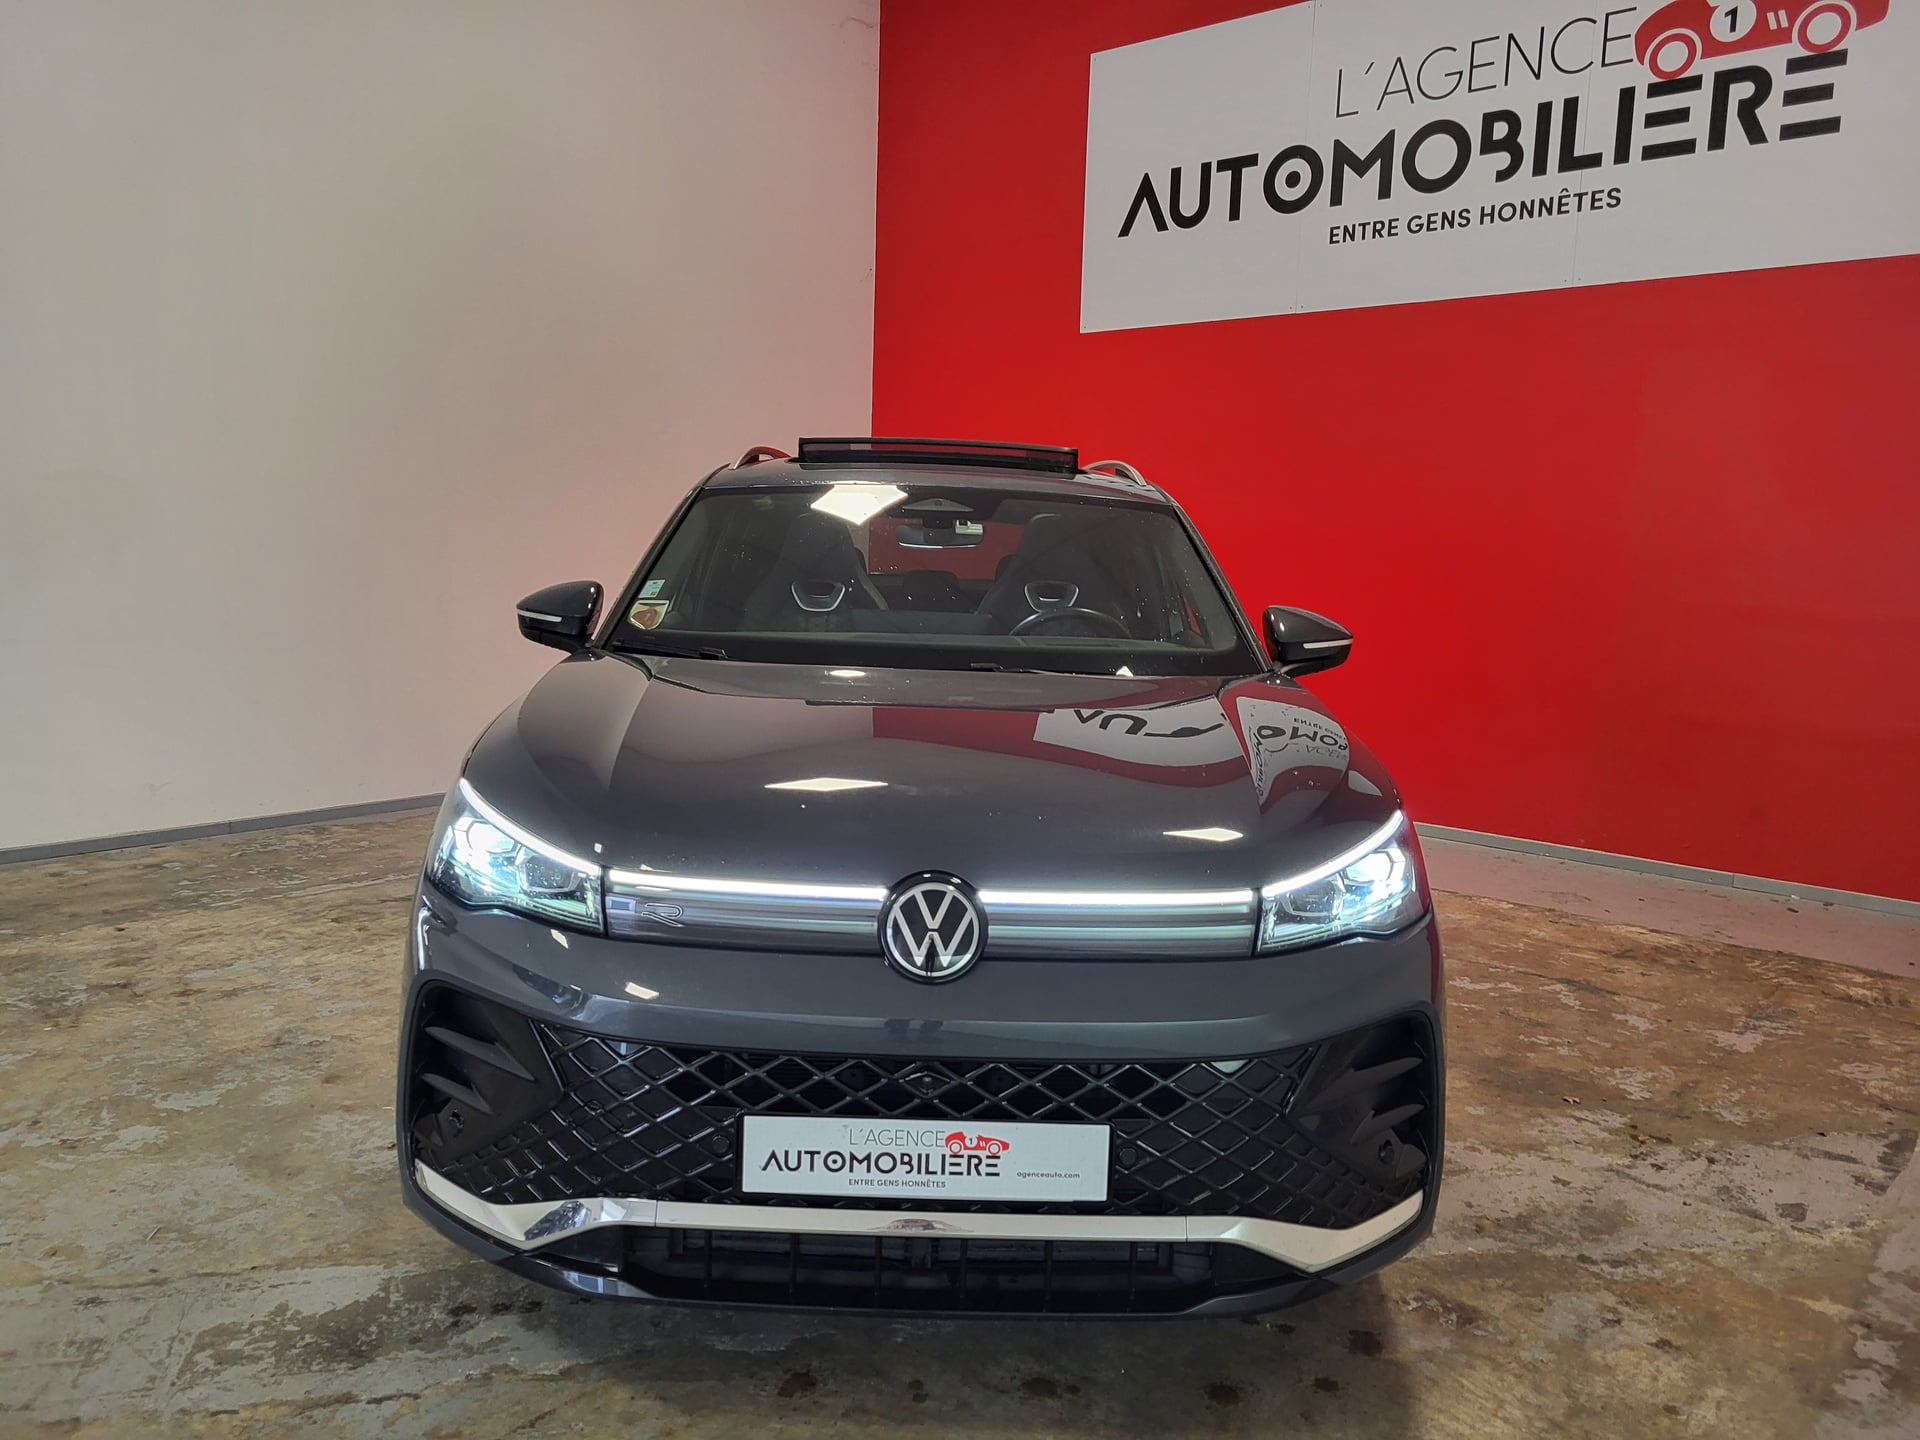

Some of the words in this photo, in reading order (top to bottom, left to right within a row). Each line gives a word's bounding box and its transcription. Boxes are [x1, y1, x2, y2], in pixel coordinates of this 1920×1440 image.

[1723, 6, 1739, 34] 1
[1335, 6, 1637, 118] L'AGENCE
[1329, 217, 1400, 245] ENTRE
[1406, 207, 1472, 235] GENS
[1479, 187, 1623, 225] HONNÊTES
[849, 1128, 946, 1148] L'AGENCE
[848, 1178, 875, 1187] ENTRE
[877, 1178, 900, 1187] GENS
[901, 1177, 947, 1189] HONNÊTES
[1016, 1170, 1081, 1179] agenceauto.com
